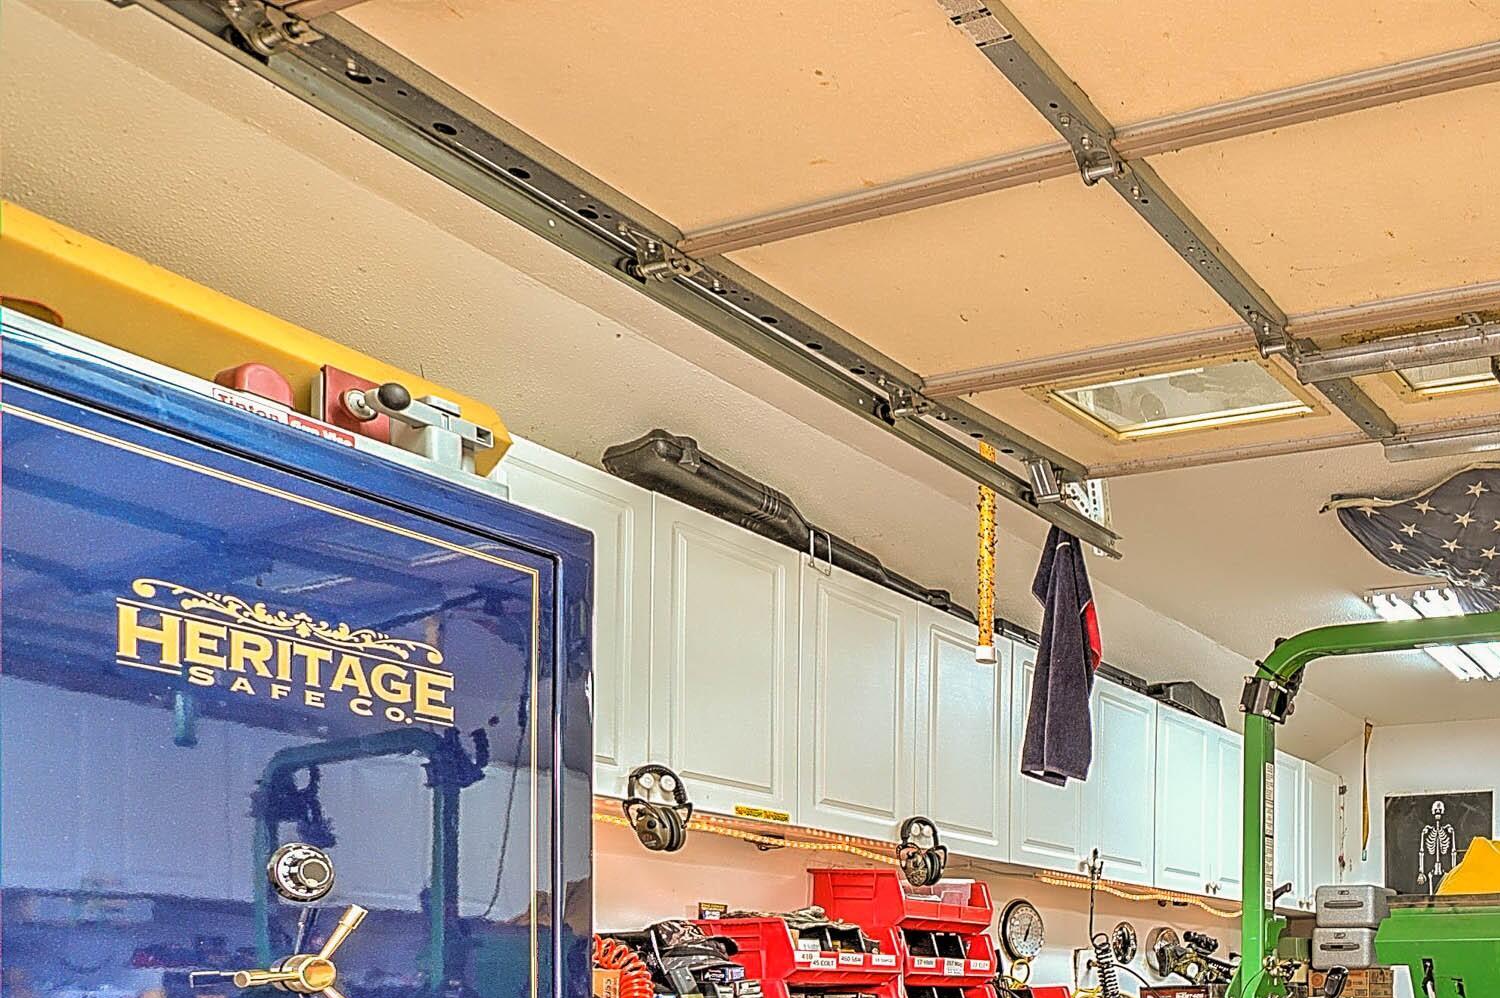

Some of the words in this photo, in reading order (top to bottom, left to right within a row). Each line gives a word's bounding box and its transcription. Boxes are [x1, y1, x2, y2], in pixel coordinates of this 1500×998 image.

[116, 602, 455, 723] HERITAGE
[188, 665, 326, 709] SAFE
[349, 699, 413, 726] CO.
